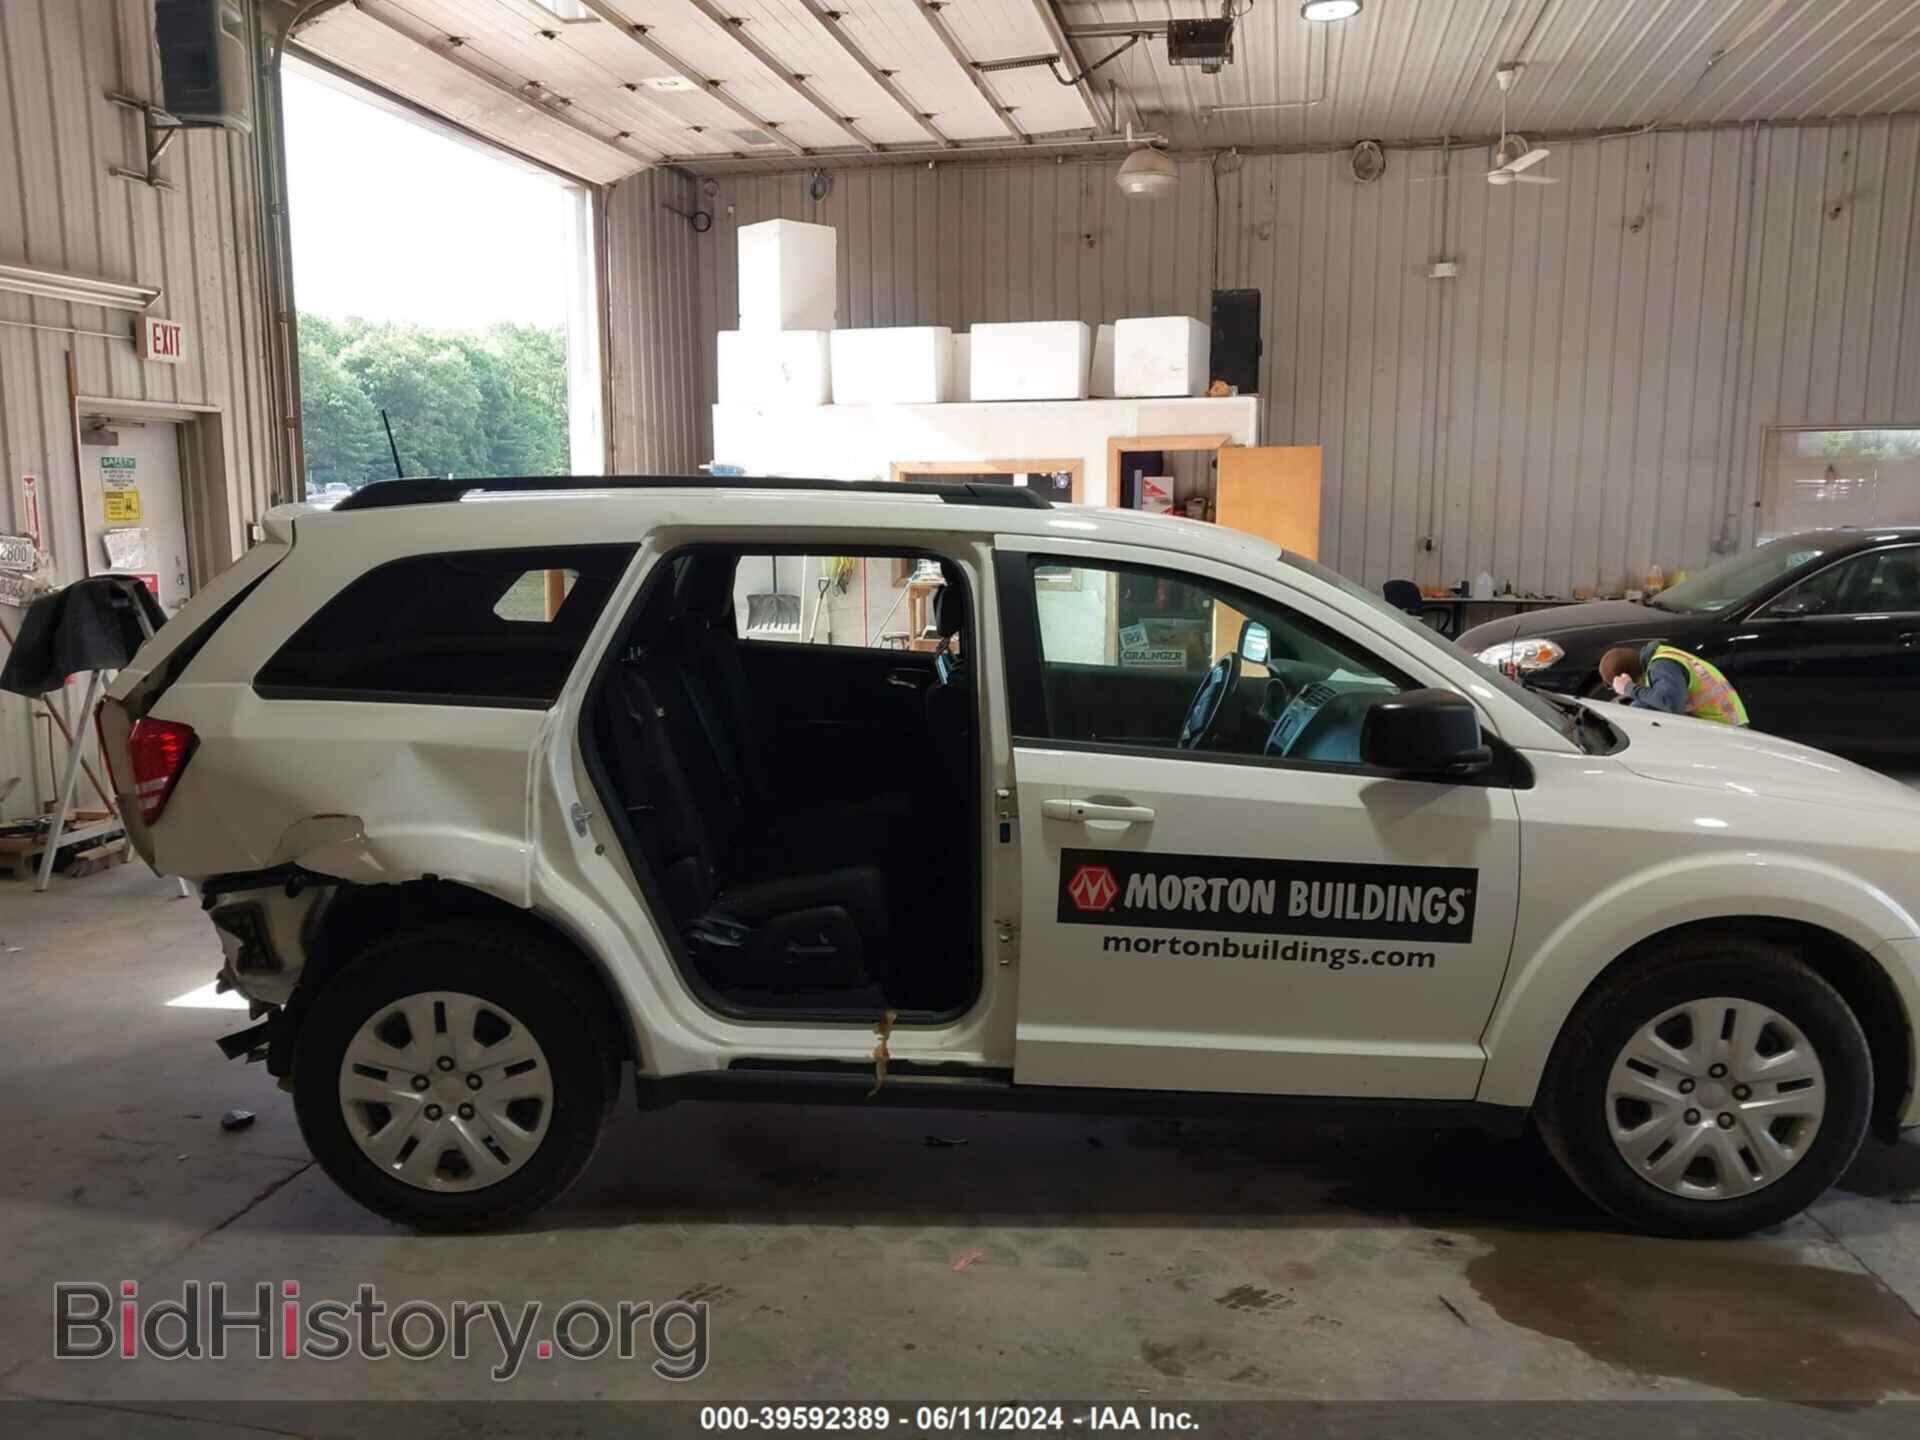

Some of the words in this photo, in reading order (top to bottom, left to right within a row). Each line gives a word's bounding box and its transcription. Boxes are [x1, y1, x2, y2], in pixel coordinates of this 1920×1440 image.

[152, 322, 181, 357] EXIT
[0, 543, 28, 562] 2800
[1124, 872, 1276, 915] MORTON
[1288, 880, 1467, 925] BUILDINGS
[1102, 934, 1436, 970] mortonbuildings.com
